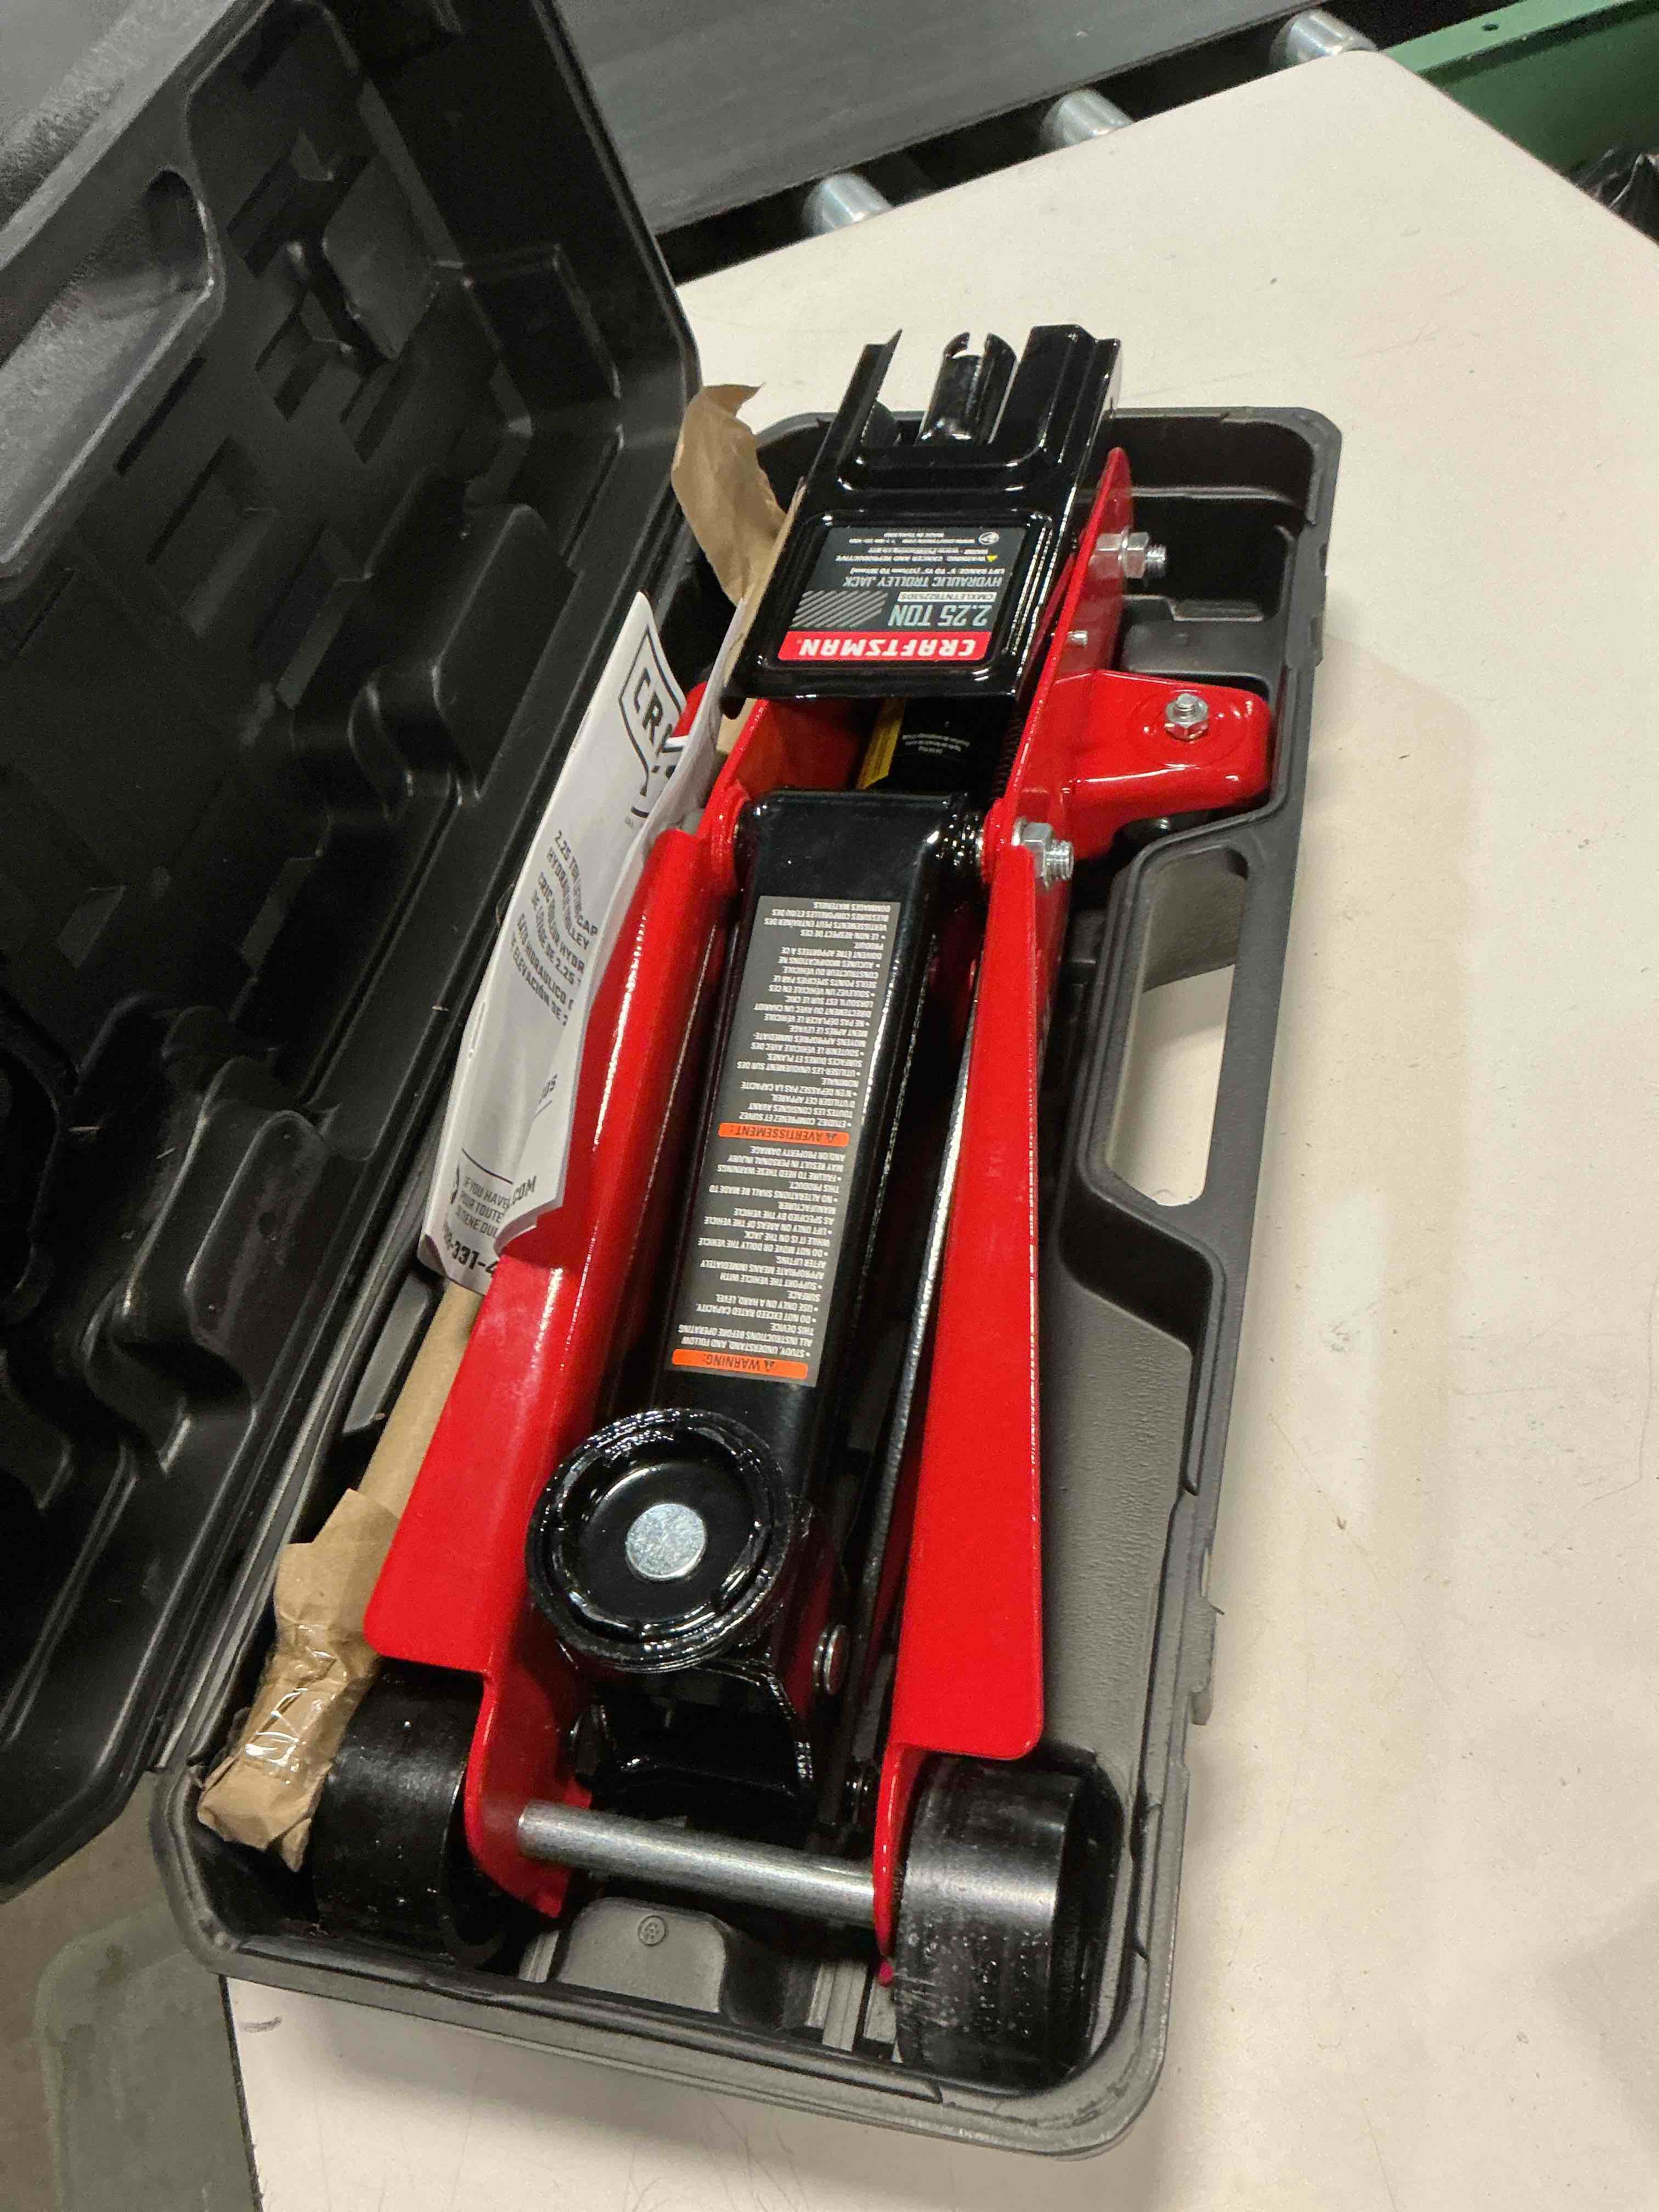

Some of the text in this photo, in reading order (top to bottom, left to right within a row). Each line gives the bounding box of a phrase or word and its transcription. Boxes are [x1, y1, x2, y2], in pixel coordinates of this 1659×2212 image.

[840, 577, 1003, 587] HYDRAULIC TROLLEY JACK
[885, 605, 993, 626] 2.25 TON
[797, 639, 979, 656] CRAFTSMAN
[554, 829, 572, 861] 2.25
[735, 1125, 822, 1142] AVERTISSEMENT
[781, 1148, 817, 1159] PROPERTY
[726, 1154, 844, 1171] MAY RESULT IN PERSONAL INJURY
[715, 1164, 837, 1182] FAILURE TO HEED THESE WARNINGS
[708, 1184, 833, 1203] NO ALTERATIONS SHALL BE MADE TO
[822, 1183, 840, 1193] THIS
[732, 1207, 834, 1224] AS SPECIFIED BY THE VEHICLE
[703, 1215, 827, 1235] LIFT ONLY ON AREAS OF THE VEHICLE
[763, 1232, 778, 1242] THE
[777, 1234, 790, 1243] ON
[789, 1235, 799, 1244] IS
[806, 1236, 831, 1246] WHILE
[697, 1237, 823, 1257] DO NOT MOVE OR DOLLY THE VEHICLE
[699, 1259, 825, 1279] APPROPRIATE MEANS IMMEDIATELY
[803, 1258, 827, 1268] AFTER
[719, 1272, 817, 1290] SUPPORT THE VEHICLE WITH
[714, 1293, 736, 1304] LEVEL
[764, 1299, 777, 1308] ON
[776, 1300, 798, 1310] ONLY
[798, 1302, 814, 1312] USE
[695, 1302, 812, 1323] DO NOT EXCEED RATED CAPACITY.
[677, 1323, 813, 1346] ALL INSTRUCTIONS BEFORE OPERATING
[797, 1325, 815, 1335] THIS
[710, 1338, 727, 1348] AND
[701, 1353, 761, 1371] WARNING:
